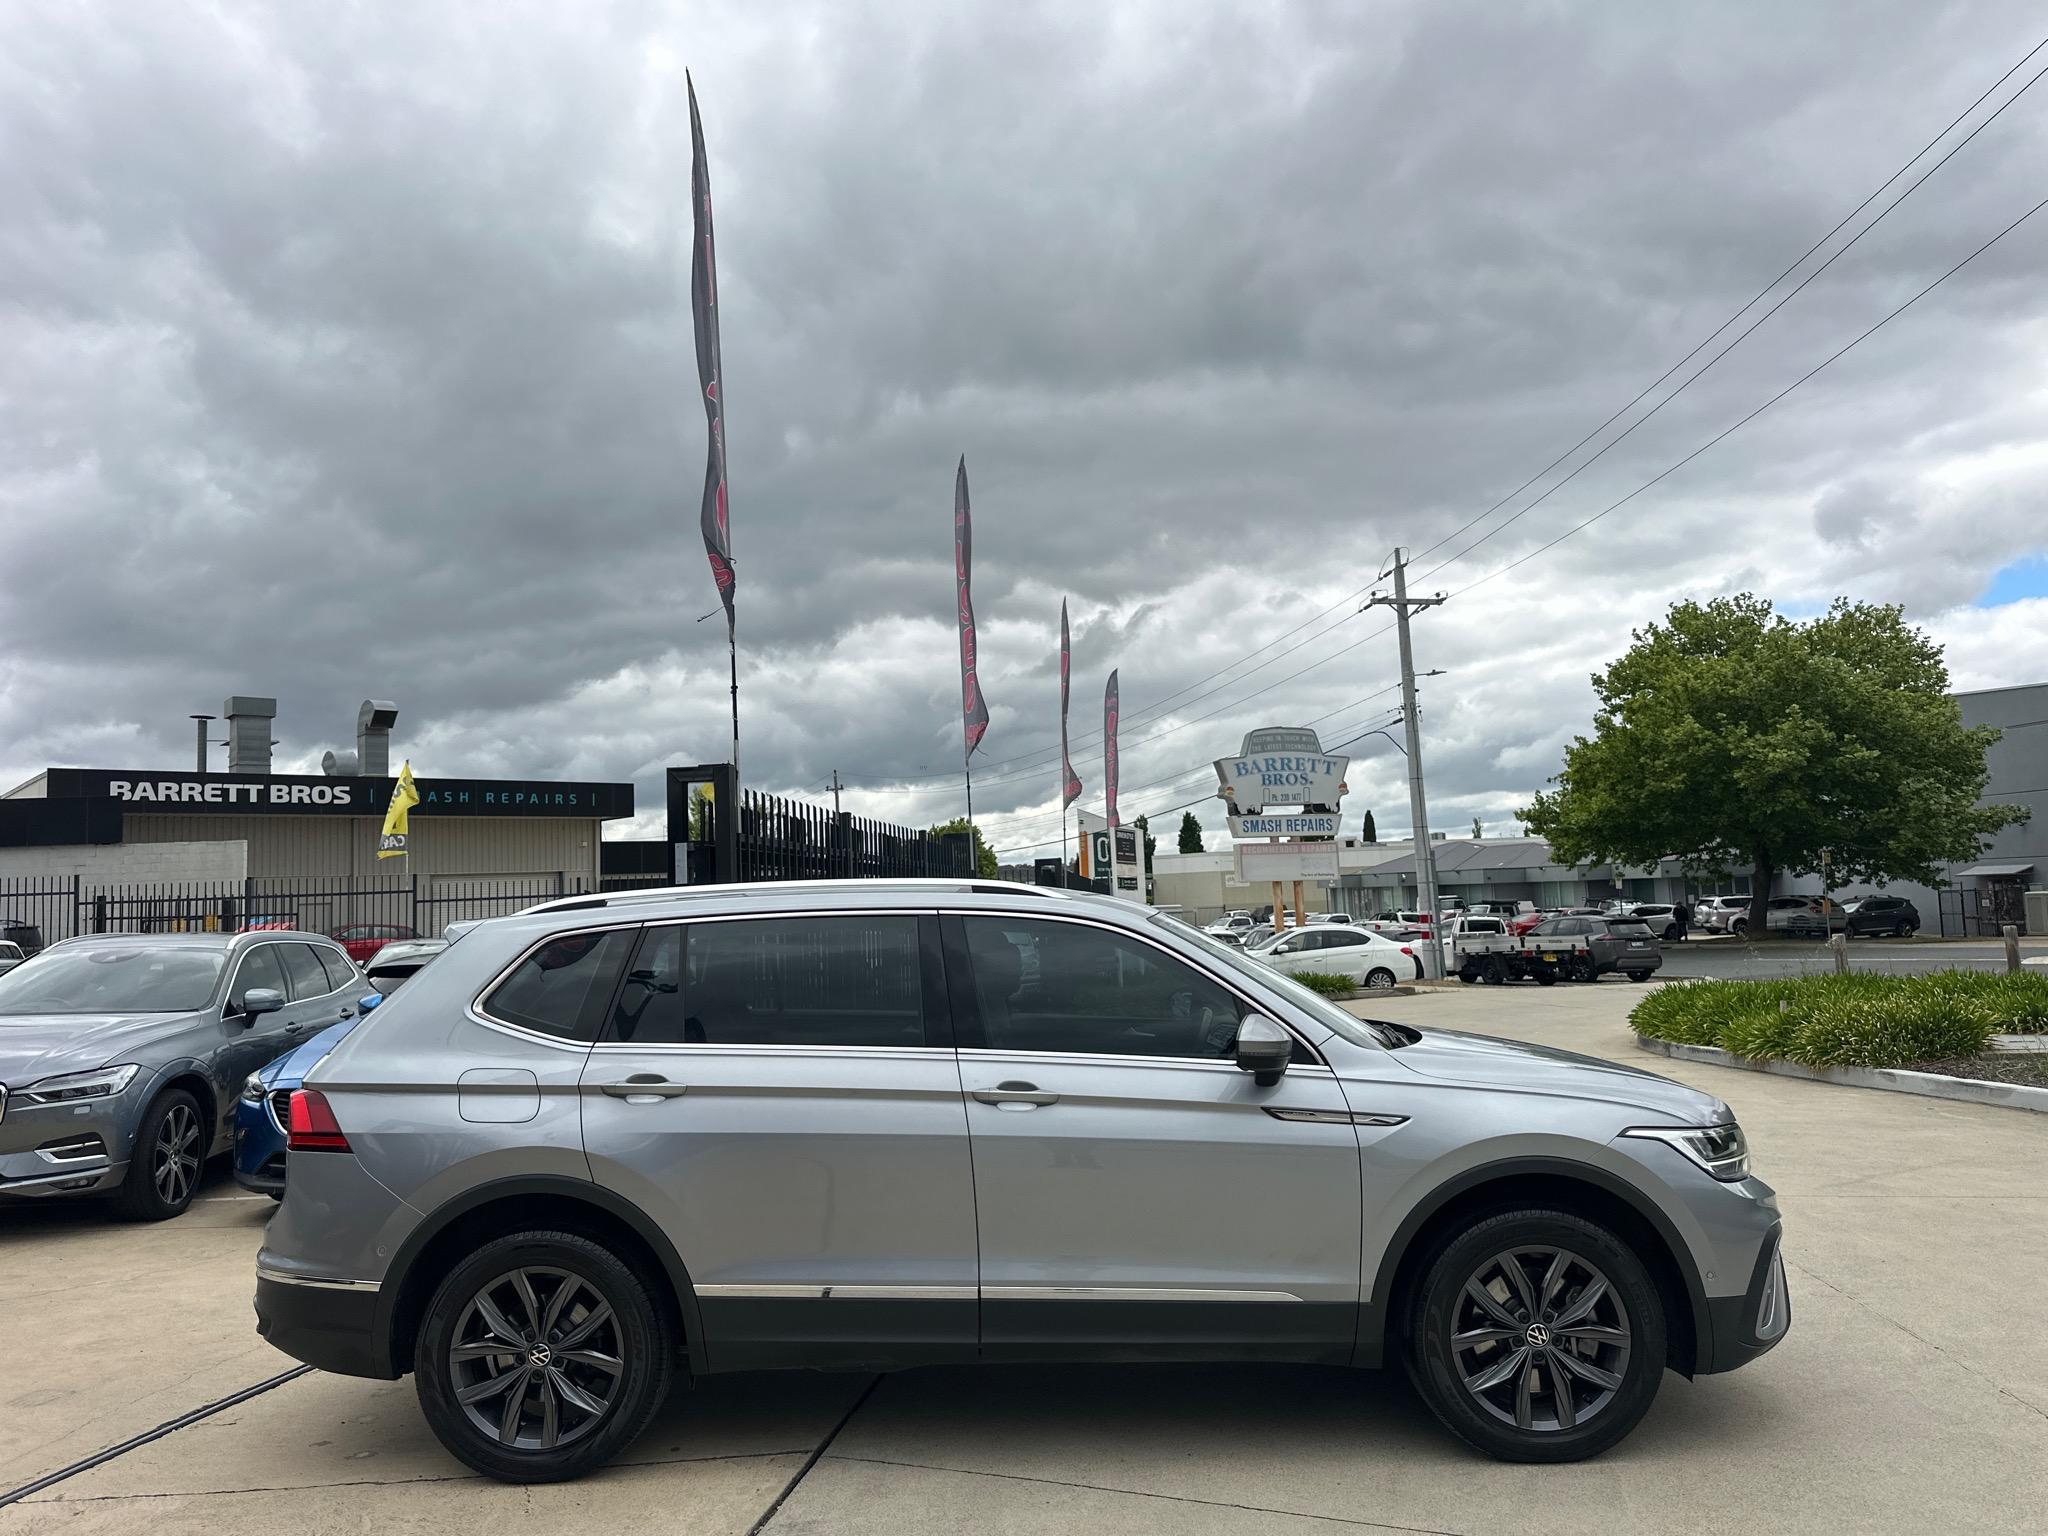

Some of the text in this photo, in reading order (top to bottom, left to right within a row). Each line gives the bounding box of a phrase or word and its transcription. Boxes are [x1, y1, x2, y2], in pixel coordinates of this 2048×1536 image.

[1234, 757, 1337, 777] BARRETT
[1261, 772, 1314, 786] BROS.
[109, 780, 351, 804] BARRETT BROS
[486, 792, 577, 805] REPAIRS
[1242, 818, 1333, 833] SMASH REPAIRS
